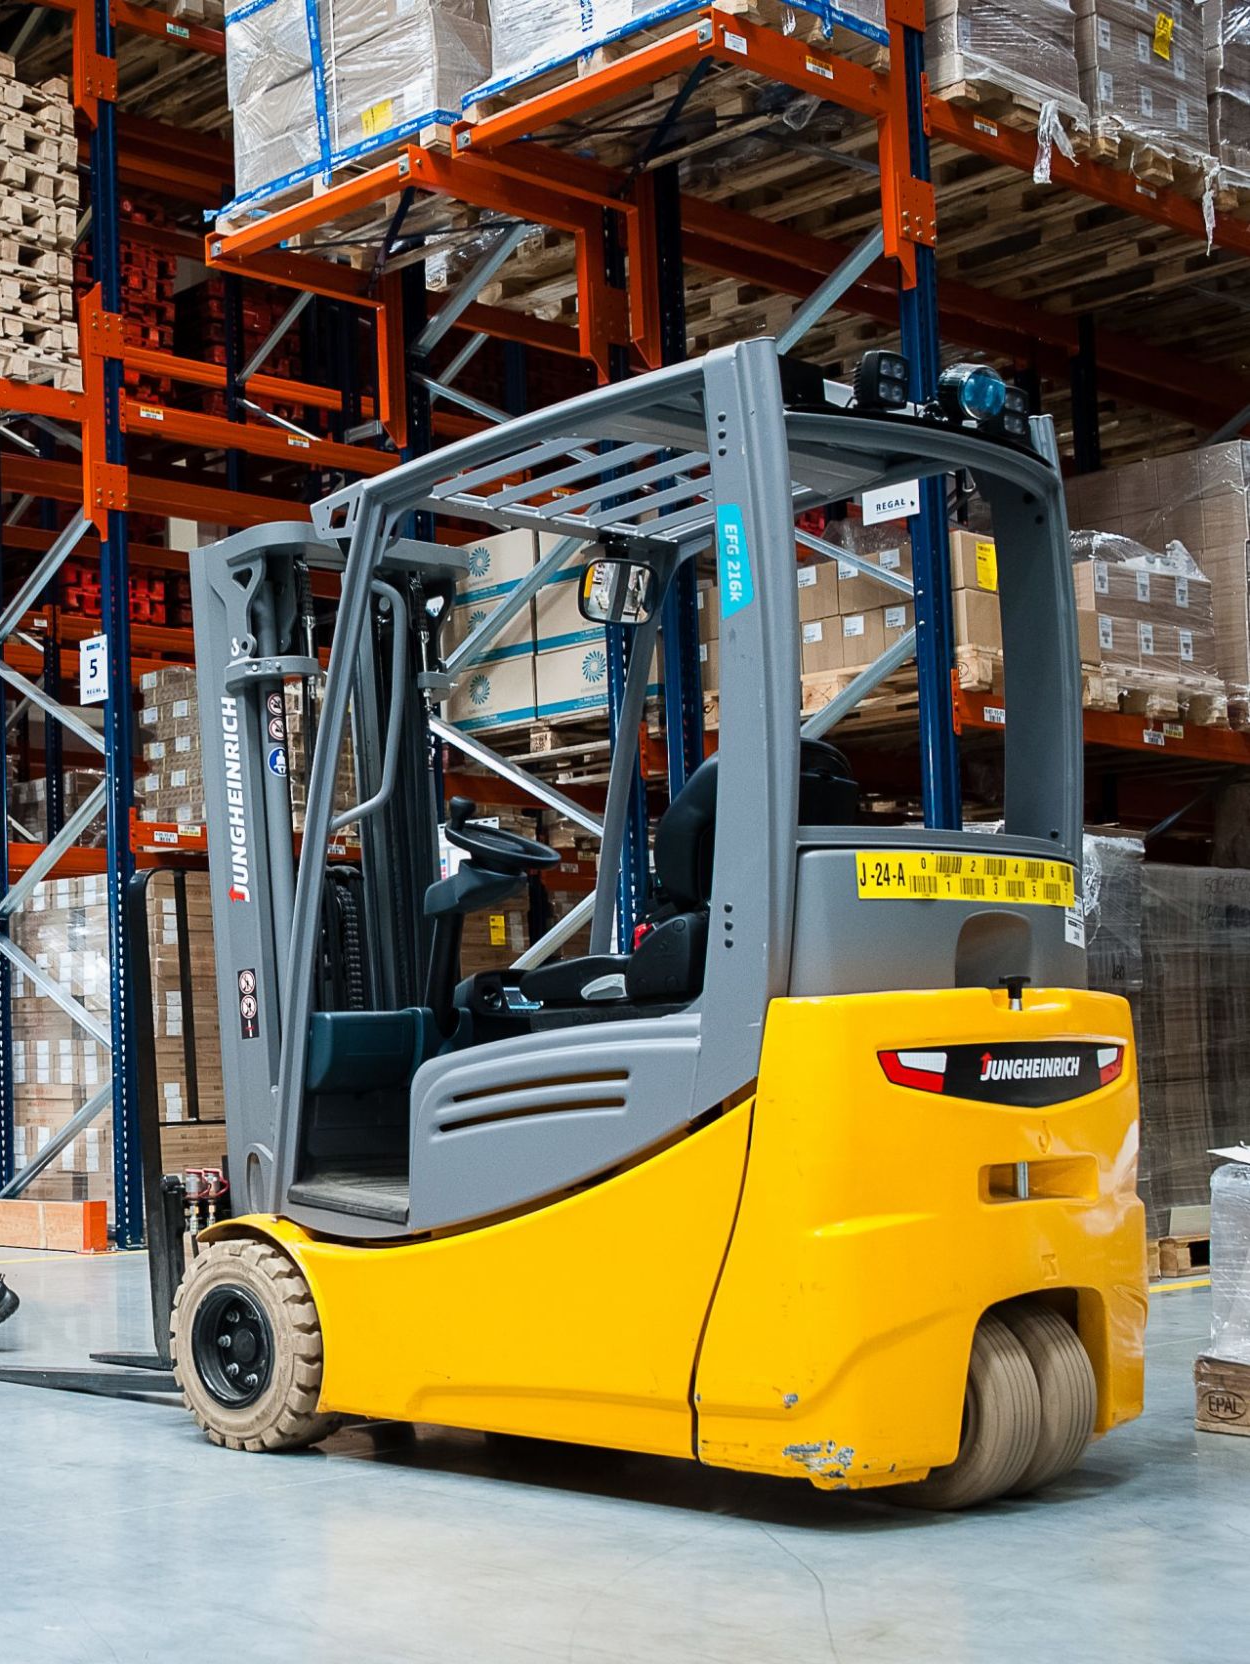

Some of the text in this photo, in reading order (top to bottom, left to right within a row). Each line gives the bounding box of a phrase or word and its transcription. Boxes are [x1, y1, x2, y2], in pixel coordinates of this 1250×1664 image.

[724, 523, 743, 603] EFG 216k
[89, 658, 98, 679] 5
[221, 696, 251, 903] JUNGHEINRICH
[921, 857, 926, 870] 0
[970, 861, 976, 873] 2
[946, 881, 951, 892] 1
[993, 883, 998, 895] 3
[980, 1056, 1080, 1081] JUNGHEINRICH
[1208, 1395, 1241, 1415] EPAL
